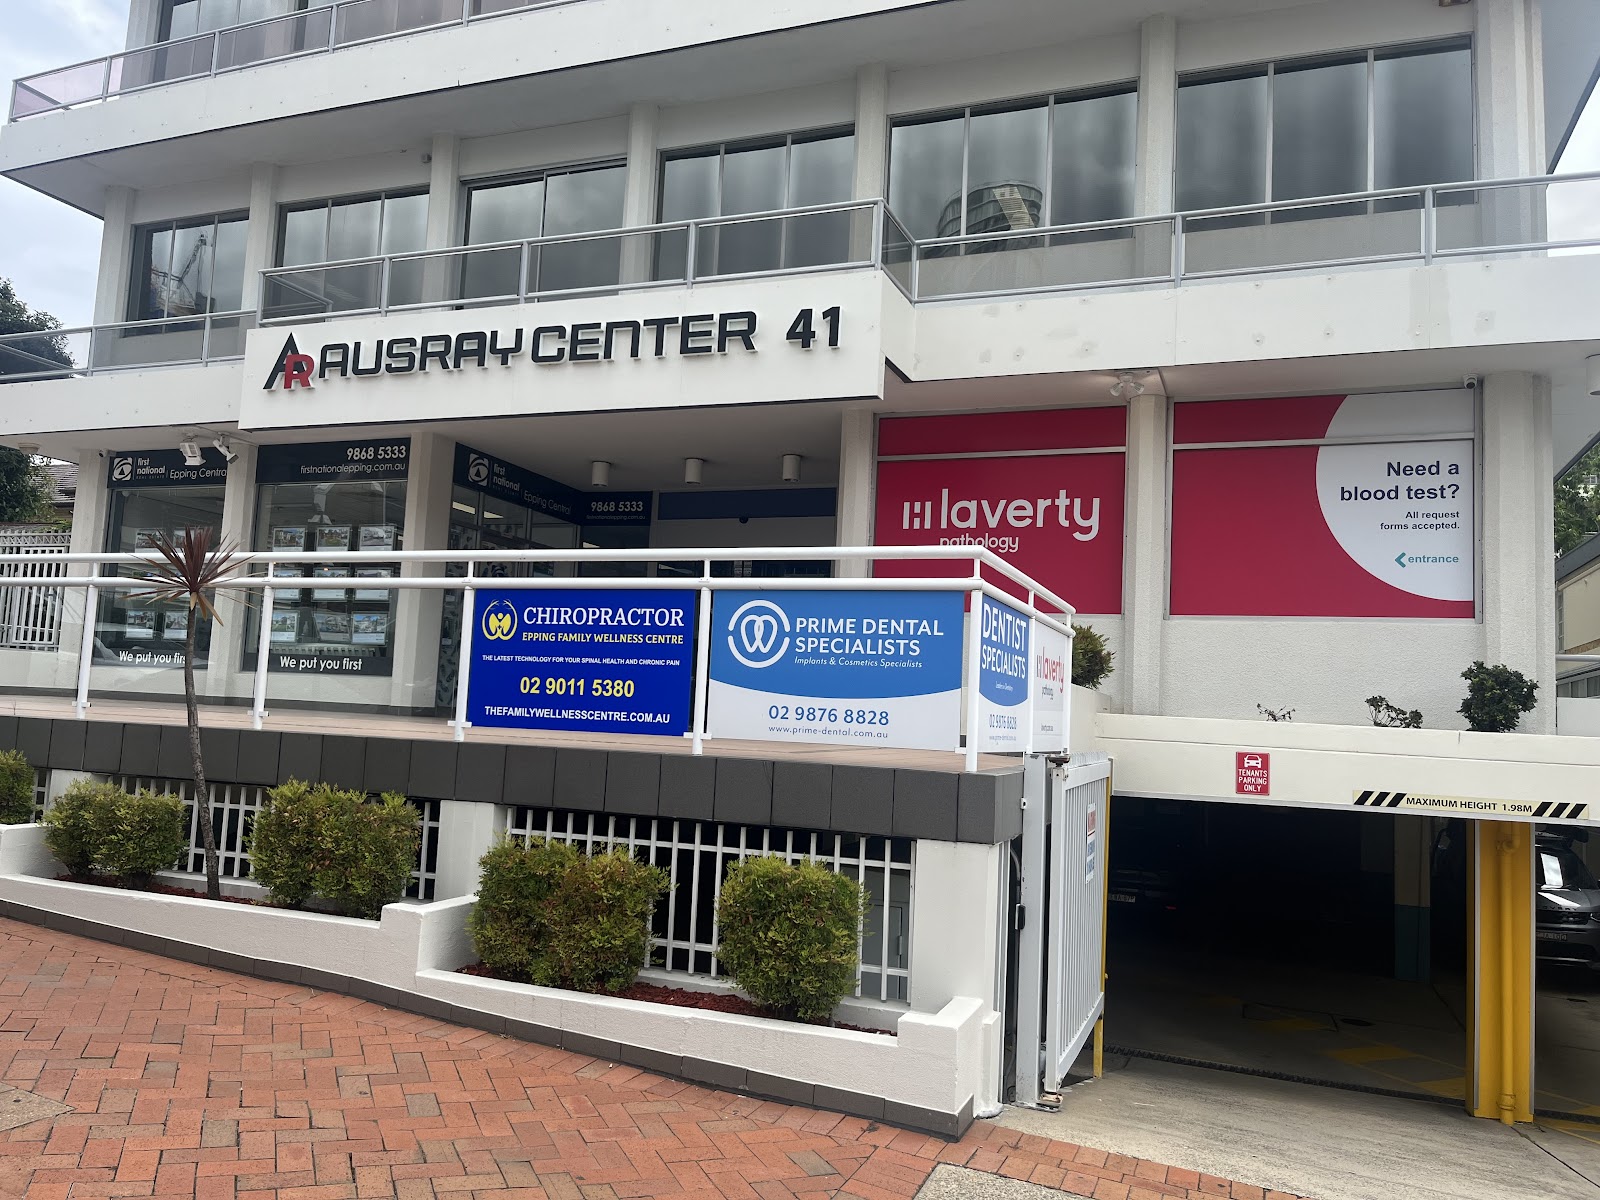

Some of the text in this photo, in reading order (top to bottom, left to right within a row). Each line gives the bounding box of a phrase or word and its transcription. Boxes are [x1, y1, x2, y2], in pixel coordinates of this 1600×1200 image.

[318, 328, 524, 379] AUSRAY
[531, 309, 758, 364] CENTER
[786, 306, 842, 350] 41
[346, 445, 406, 460] 9868 5333
[137, 457, 150, 466] first
[300, 463, 406, 474] firstnationalepping.com.au
[1386, 460, 1460, 477] Need a
[136, 465, 166, 475] national
[169, 467, 227, 480] Epping Centra
[493, 463, 506, 476] first
[492, 476, 520, 492] national
[1340, 483, 1460, 501] blood test?
[523, 490, 547, 510] Epping
[547, 499, 572, 515] Central
[591, 501, 643, 512] 9868 5333
[940, 488, 1100, 542] laverty
[1405, 511, 1460, 520] All request
[1380, 521, 1460, 531] forms accepted.
[1408, 555, 1459, 563] entrance
[523, 606, 685, 627] CHIROPRACTOR
[795, 617, 944, 636] PRIME DENTAL
[982, 602, 1027, 652] DENTIST
[522, 632, 684, 645] EPPING FAMILY WELLNESS CENTRE
[795, 637, 921, 656] SPECIALISTS
[119, 651, 186, 665] We put you firs
[279, 656, 363, 671] We put you first
[514, 655, 552, 663] TECHNOLOGY
[564, 656, 581, 664] YOUR
[602, 657, 625, 665] HEALTH
[638, 658, 666, 666] CHRONIC
[794, 656, 923, 669] Implants & Cosmetics Specialists
[981, 644, 1026, 680] SPECIALISTS
[1042, 646, 1065, 694] laverty
[520, 676, 635, 698] 02 9011 5380
[484, 706, 671, 724] THEFAMILYWELLNESSCENTRE.COM.AU
[768, 705, 889, 726] 02 9876 8828
[768, 724, 889, 739] www.prime-dental.com.au
[1238, 769, 1268, 777] TENANTS
[1238, 776, 1267, 785] PARKING
[1243, 784, 1262, 792] ONLY
[1406, 797, 1532, 813] MAXIMUM HEIGHT 1.98M
